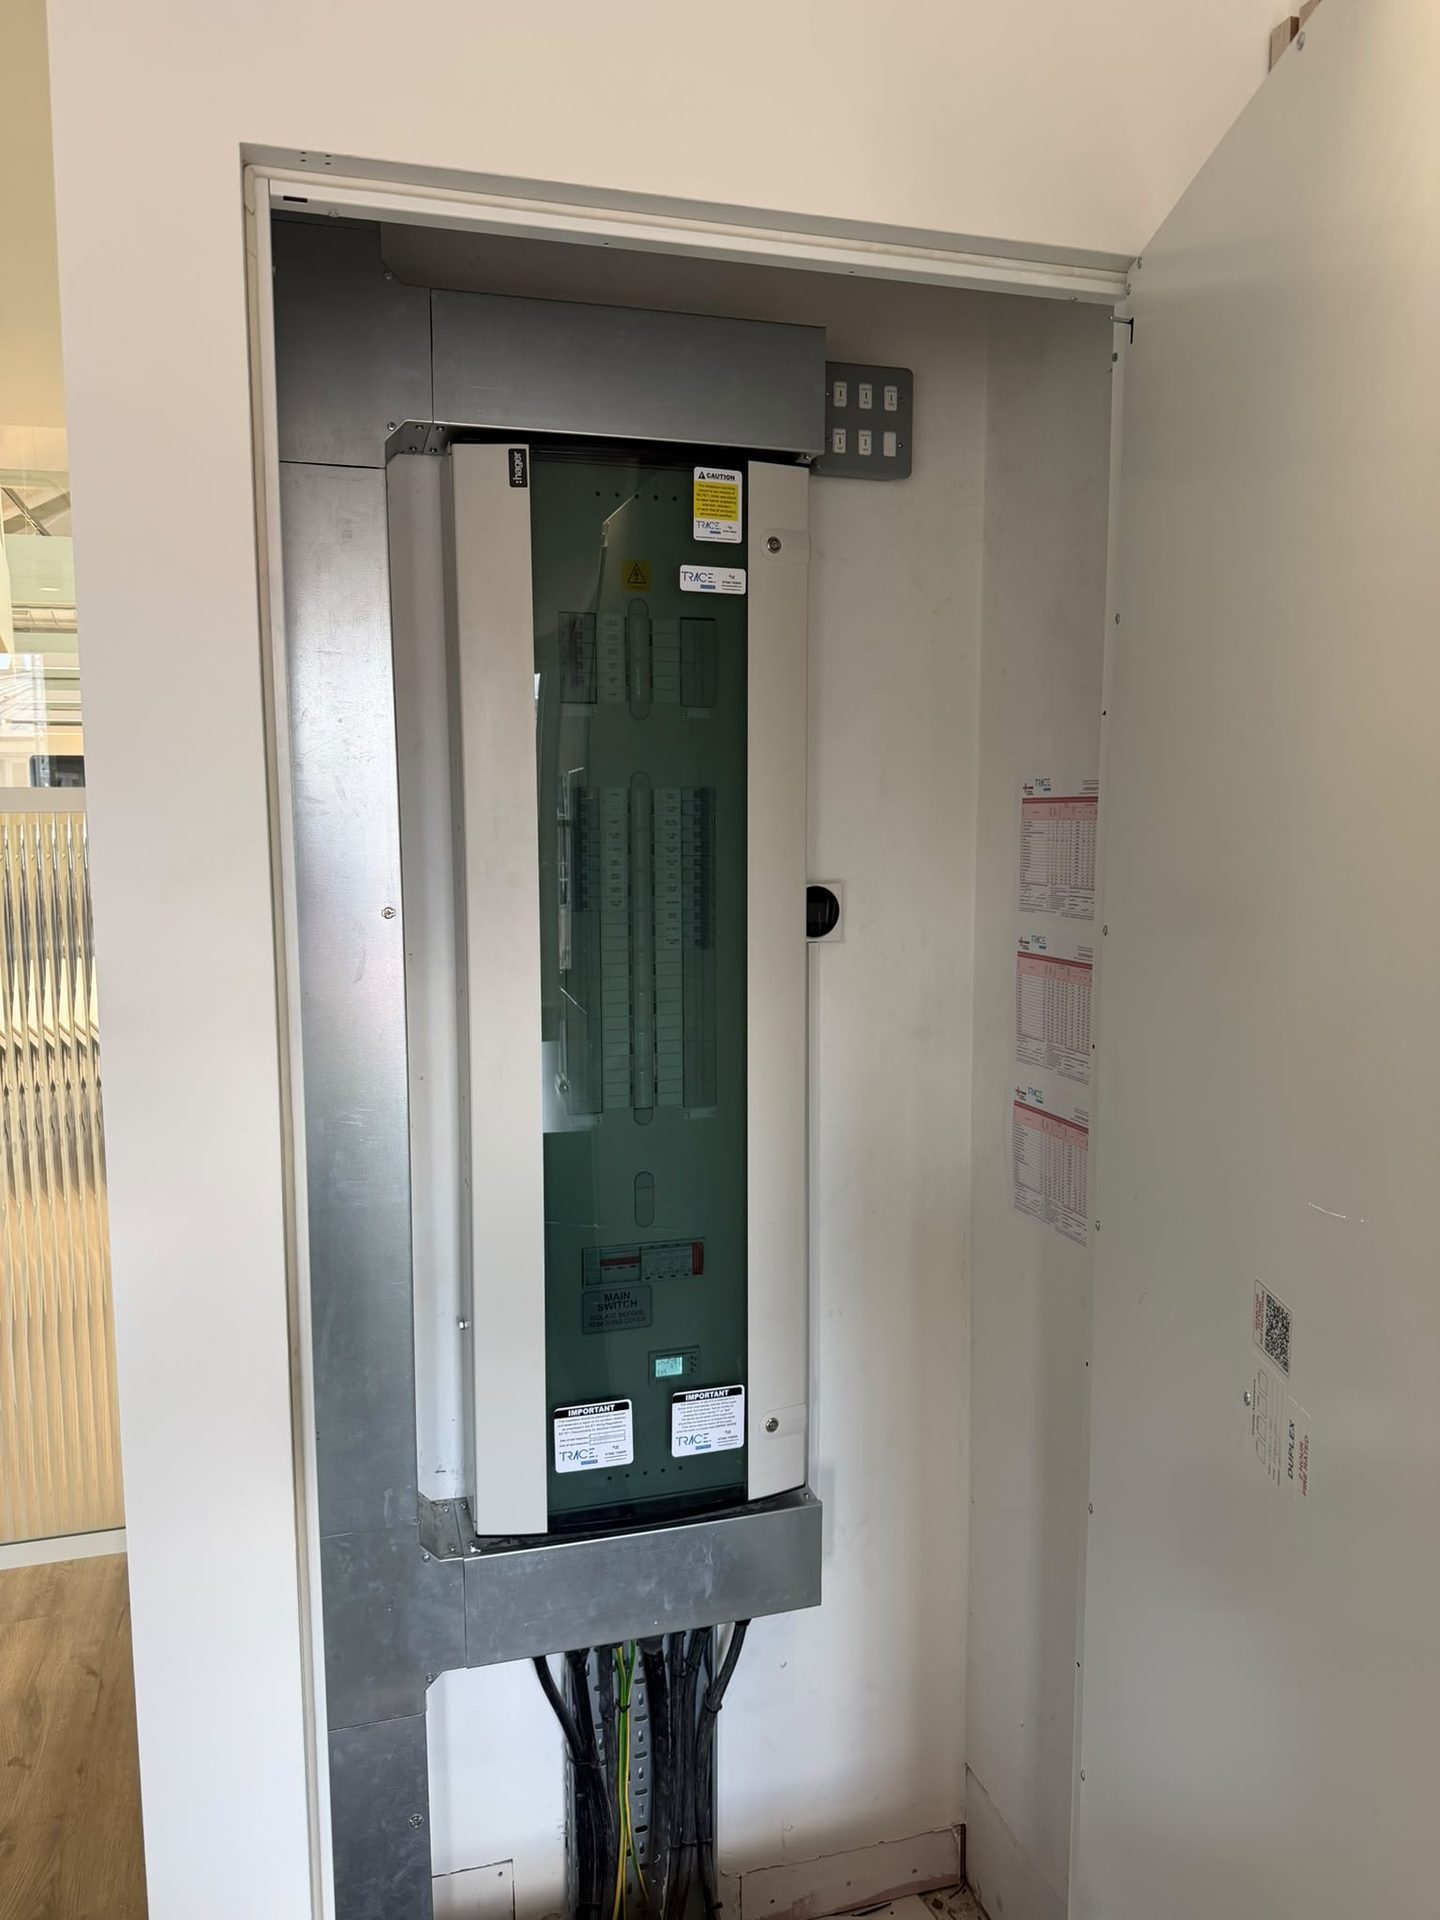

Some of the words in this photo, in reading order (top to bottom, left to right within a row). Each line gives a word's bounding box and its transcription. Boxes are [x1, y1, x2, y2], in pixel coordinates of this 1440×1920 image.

[706, 472, 736, 481] CAUTION
[696, 520, 720, 530] TRACE
[681, 570, 714, 583] TRACE
[604, 1291, 631, 1301] MAIN
[597, 1299, 638, 1312] SWITCH
[685, 1389, 730, 1401] IMPORTANT
[568, 1404, 615, 1417] IMPORTANT
[676, 1433, 709, 1446] TRACE
[559, 1448, 595, 1461] TRACE
